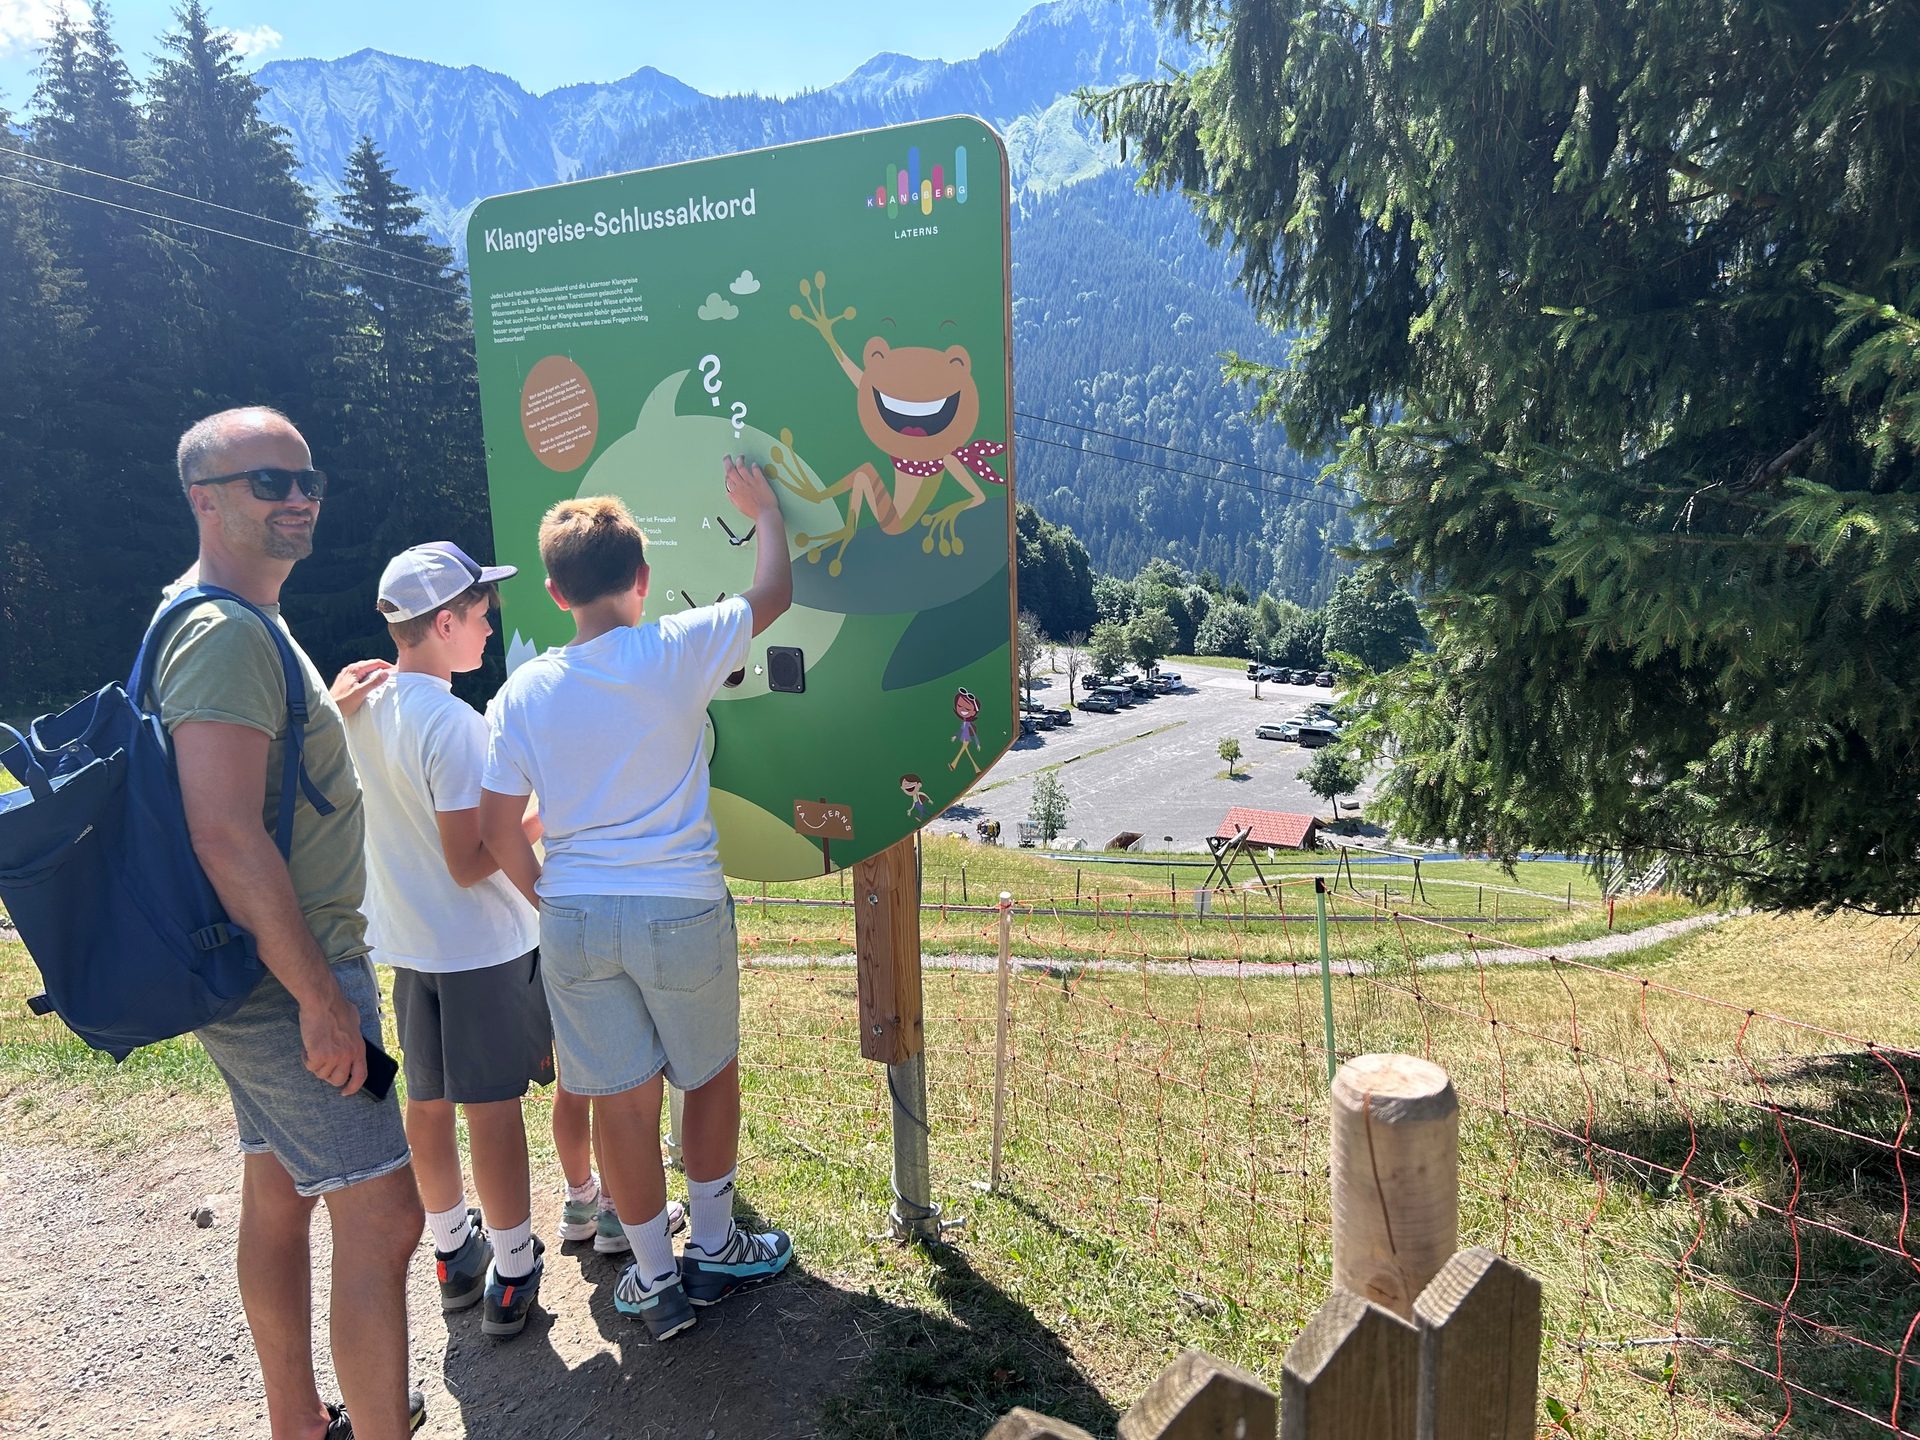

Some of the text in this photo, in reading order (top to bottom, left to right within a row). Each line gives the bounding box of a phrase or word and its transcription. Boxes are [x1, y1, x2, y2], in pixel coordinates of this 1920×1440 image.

[867, 186, 966, 208] KLANGBERG
[485, 188, 756, 252] Klangreise-Schlussakkord
[894, 226, 938, 240] LATERNS
[702, 517, 711, 529] A
[666, 590, 675, 601] C
